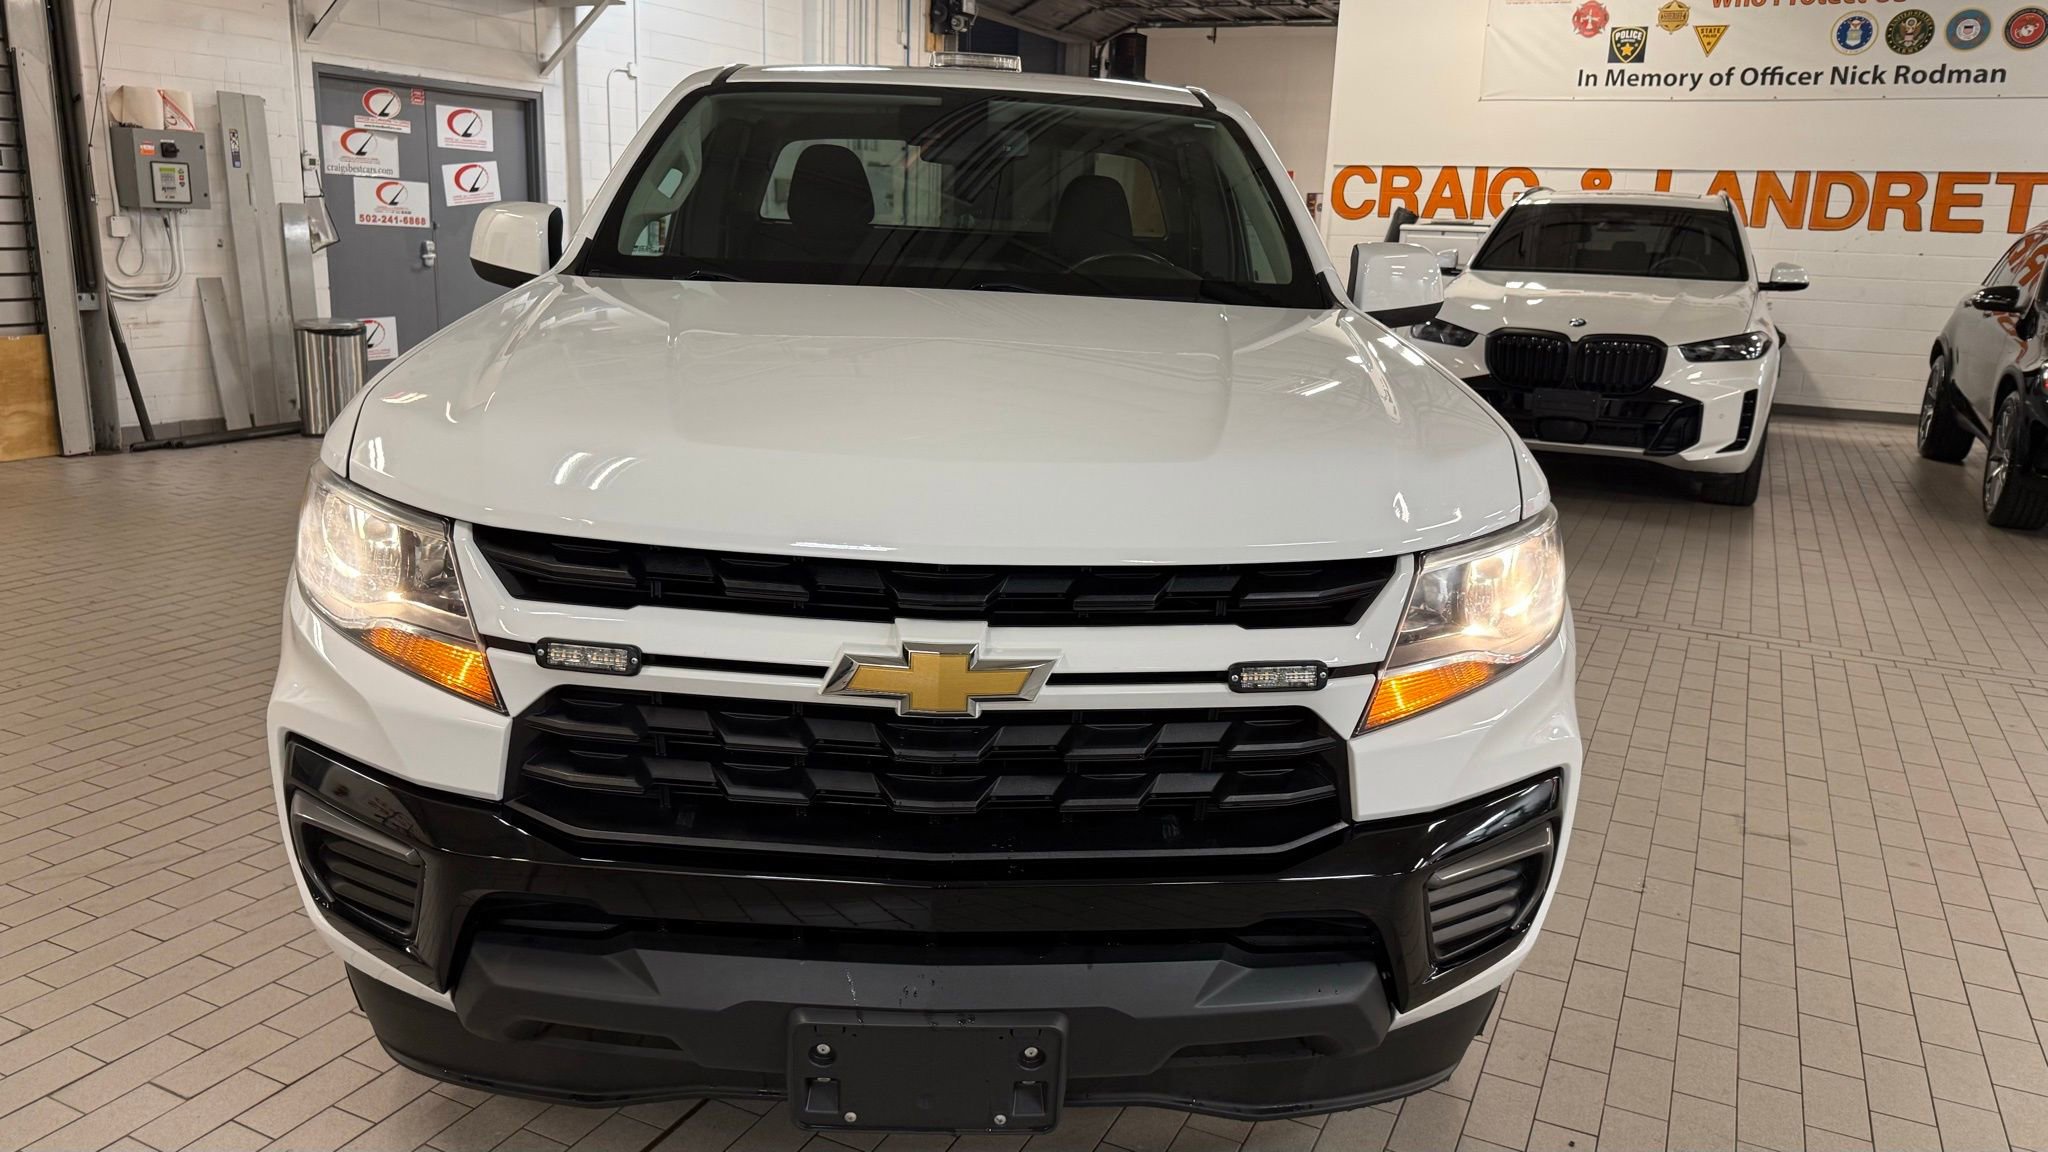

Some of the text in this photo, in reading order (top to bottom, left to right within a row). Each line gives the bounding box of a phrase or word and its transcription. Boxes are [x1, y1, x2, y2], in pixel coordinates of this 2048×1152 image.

[1615, 30, 1643, 41] POLICE
[1577, 64, 2007, 92] In Memory of Officer Nick Rodman
[326, 162, 394, 176] craigsbestcars.com
[1331, 165, 1540, 221] CRAIG
[359, 213, 427, 226] 502-241-6868
